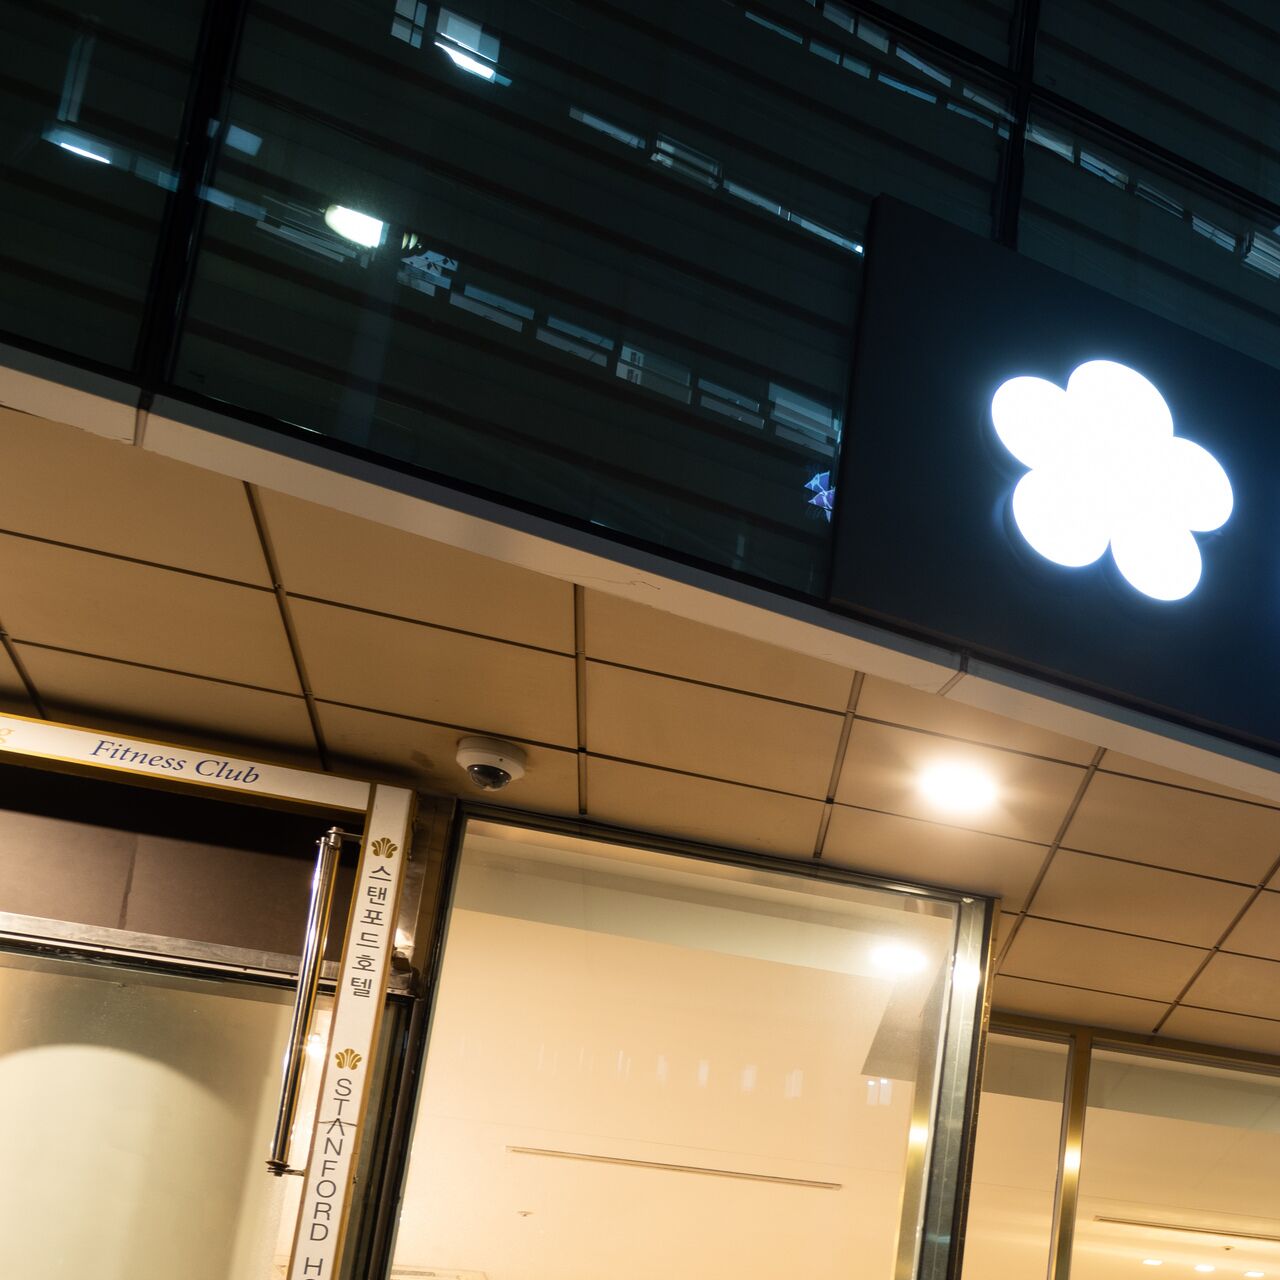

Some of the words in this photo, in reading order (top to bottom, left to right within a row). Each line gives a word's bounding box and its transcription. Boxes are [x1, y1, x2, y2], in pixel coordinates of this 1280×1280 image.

[90, 738, 188, 772] Fitness
[195, 758, 261, 784] Club
[350, 865, 393, 998] 스탠포드호텔
[309, 1077, 354, 1242] STANFORD
